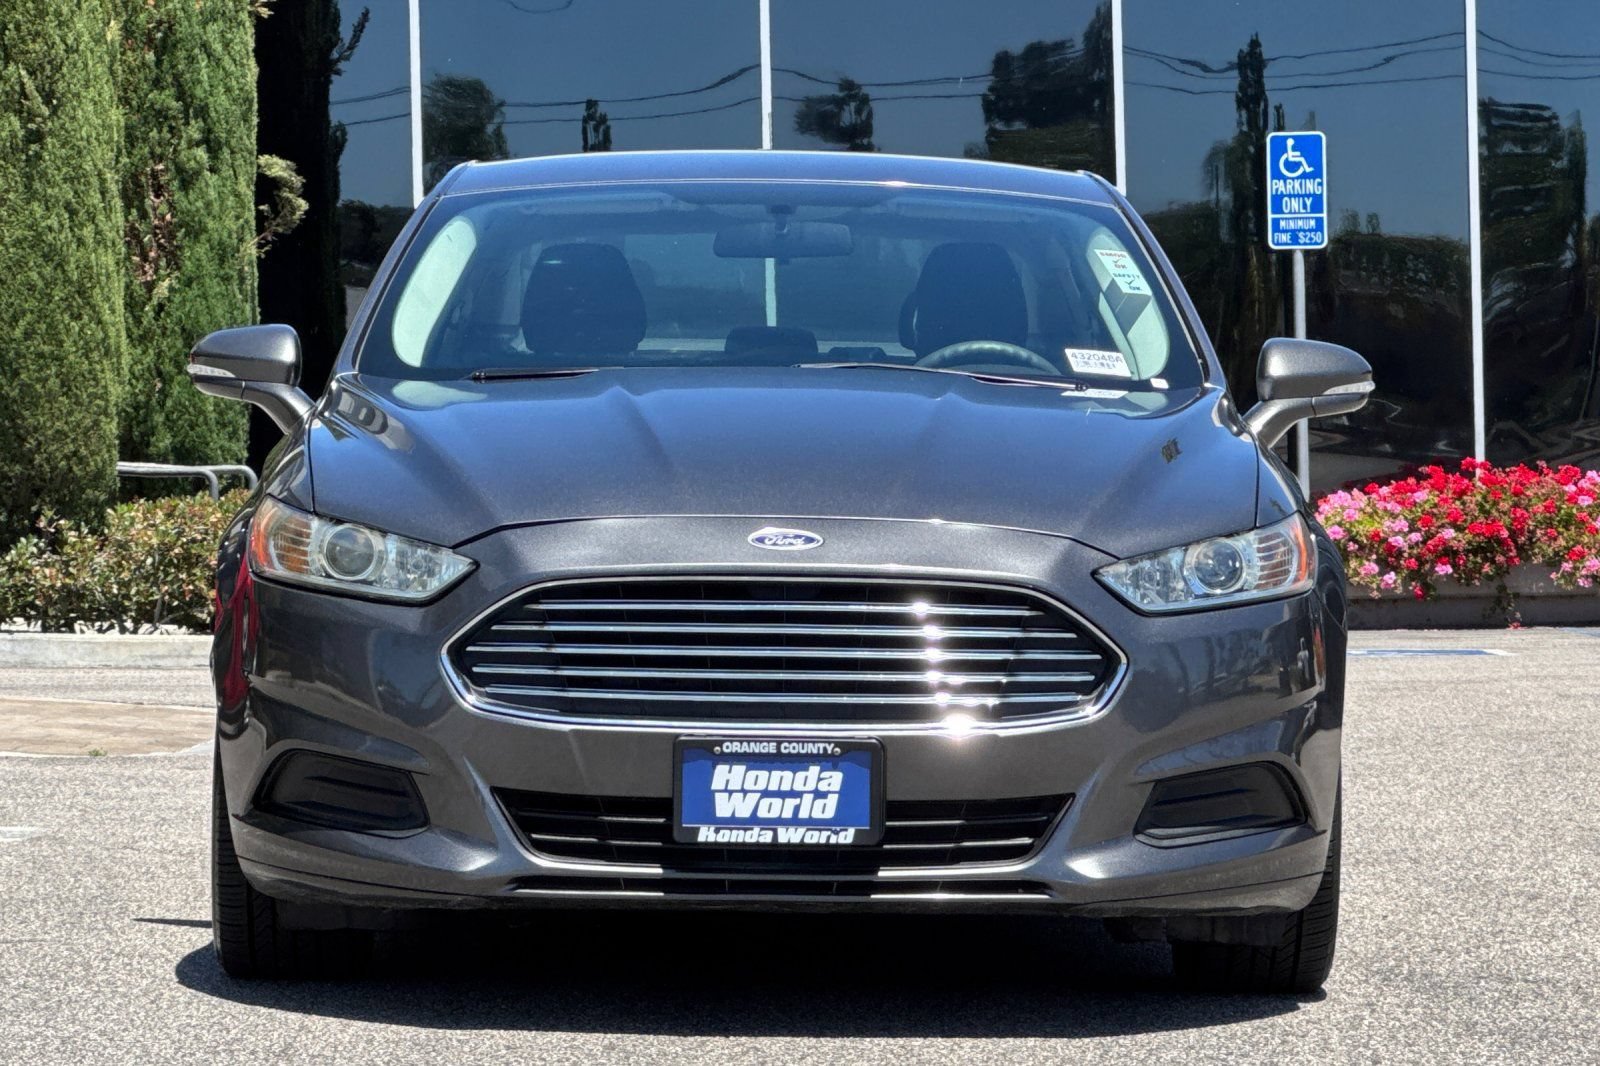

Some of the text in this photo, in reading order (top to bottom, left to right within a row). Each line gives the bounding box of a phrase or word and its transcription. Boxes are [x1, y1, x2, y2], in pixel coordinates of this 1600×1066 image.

[1272, 178, 1322, 195] PARKING
[1282, 197, 1312, 213] ONLY
[1280, 218, 1316, 230] MINIMUM
[1274, 231, 1322, 244] FINE $250
[763, 534, 805, 545] Ford
[722, 742, 835, 755] ORANGE COUNTY
[711, 764, 843, 792] Honda
[714, 792, 839, 819] World
[697, 827, 855, 845] Honda World
